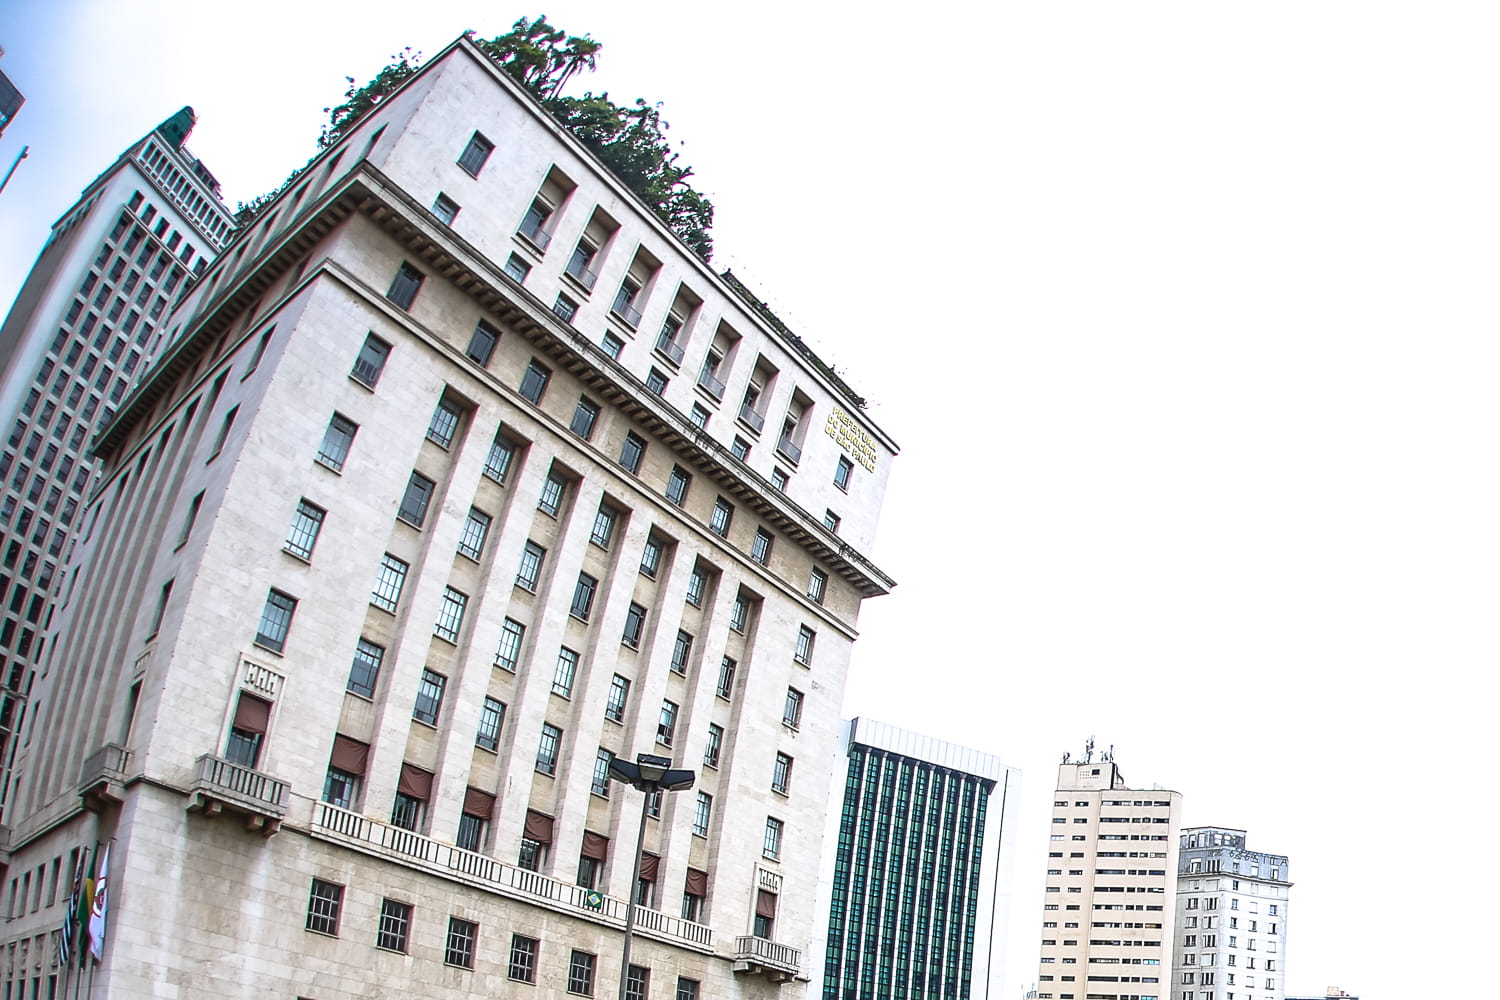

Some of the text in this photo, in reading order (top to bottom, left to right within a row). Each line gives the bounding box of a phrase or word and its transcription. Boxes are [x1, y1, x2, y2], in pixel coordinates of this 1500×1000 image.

[827, 414, 838, 429] DO
[833, 406, 877, 452] PREFEITURA
[825, 424, 836, 439] DE
[852, 448, 875, 473] PAULO
